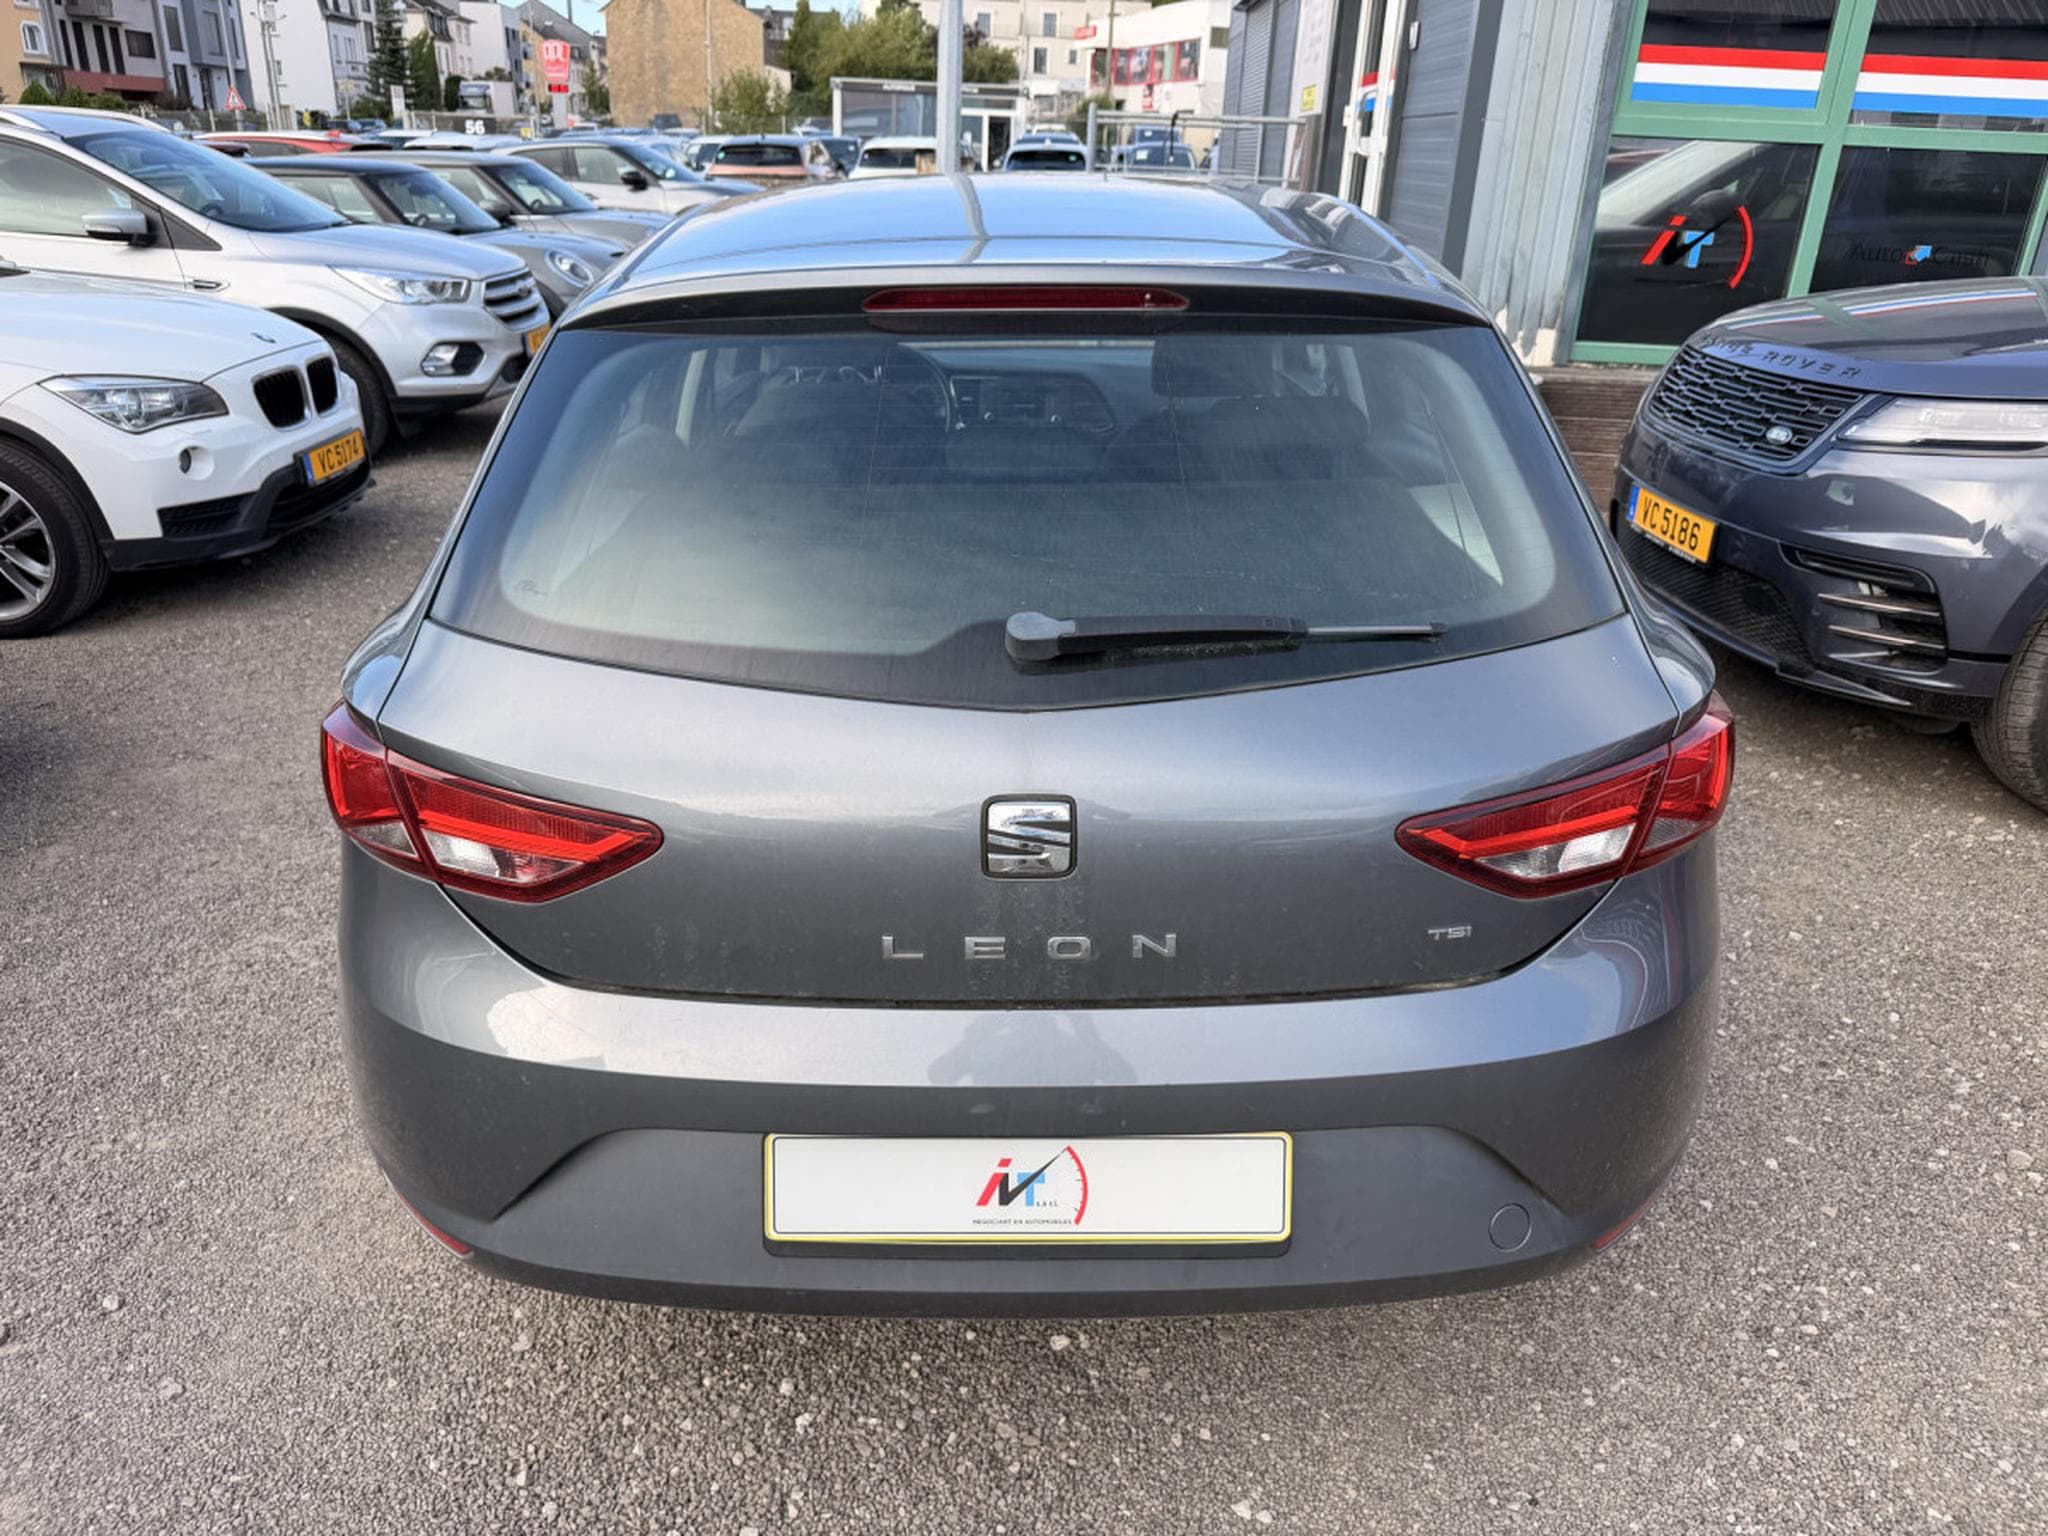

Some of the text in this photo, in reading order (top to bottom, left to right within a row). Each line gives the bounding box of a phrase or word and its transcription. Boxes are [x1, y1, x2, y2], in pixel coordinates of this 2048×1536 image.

[464, 119, 486, 135] 56
[1761, 351, 1863, 378] ROVER
[317, 435, 359, 473] VC 5174
[1643, 496, 1701, 551] VC 5186
[882, 934, 1177, 960] LEON
